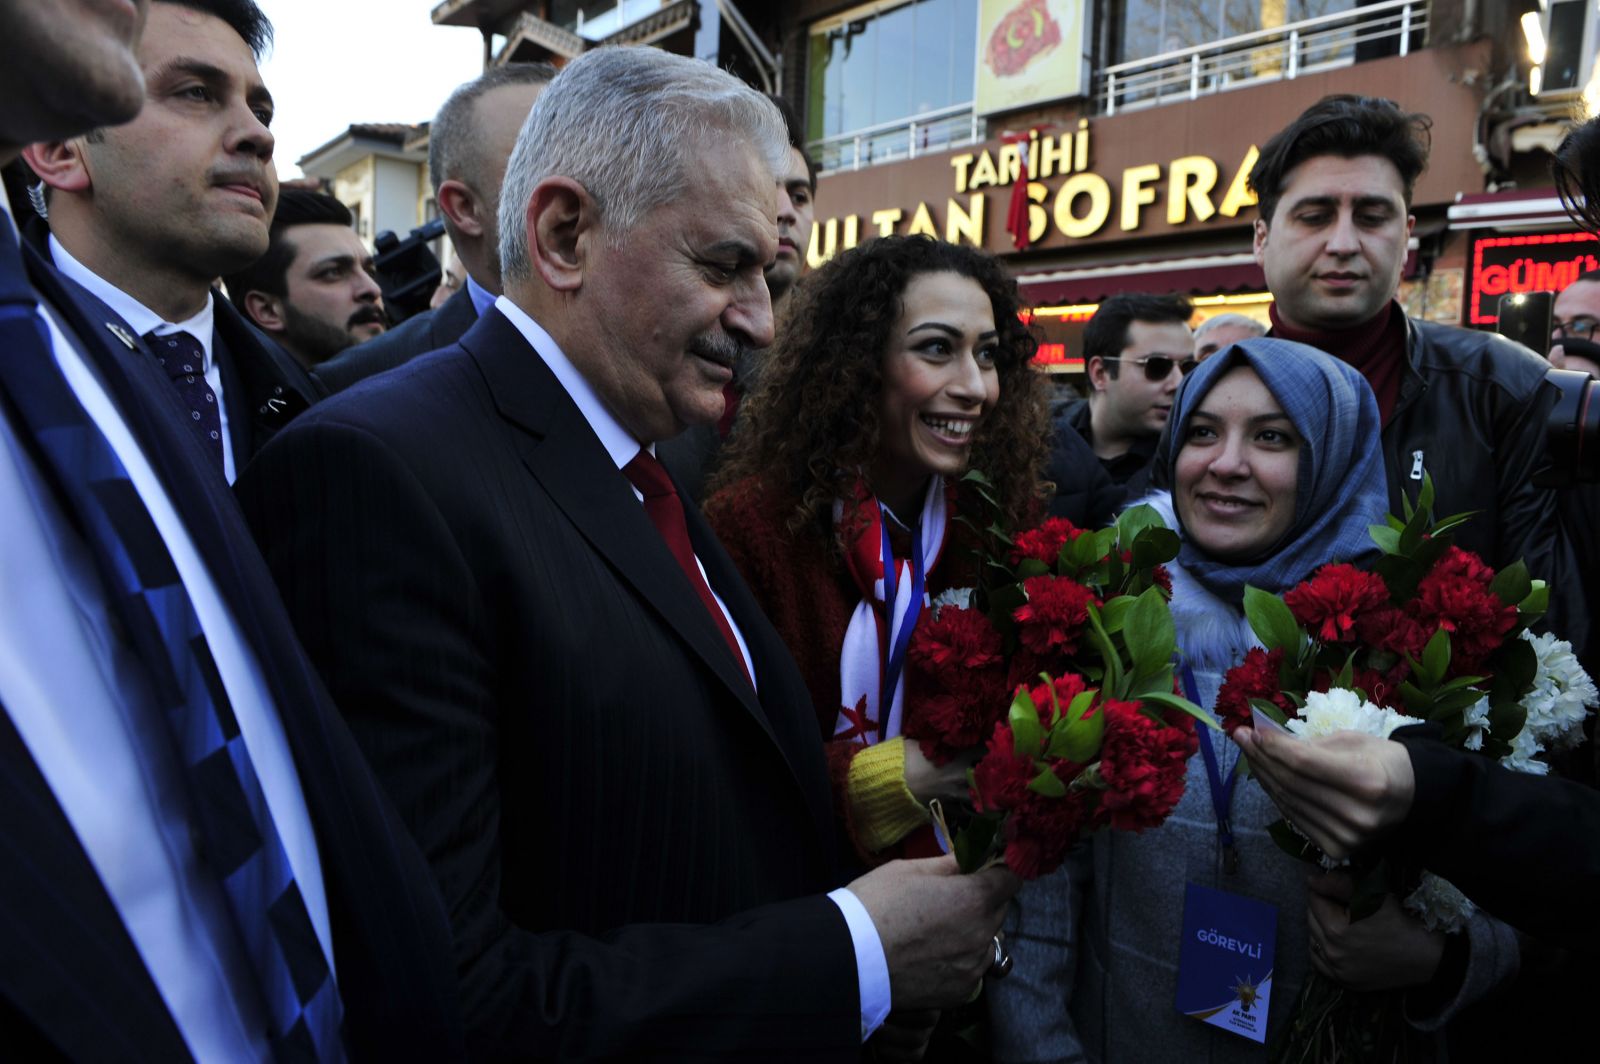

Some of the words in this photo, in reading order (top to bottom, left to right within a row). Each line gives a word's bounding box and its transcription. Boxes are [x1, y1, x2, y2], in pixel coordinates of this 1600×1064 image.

[951, 118, 1089, 193] TARİHİ
[806, 192, 985, 269] ULTAN
[1480, 254, 1599, 296] GÜMÜ
[1197, 928, 1262, 960] GÖREVLİ
